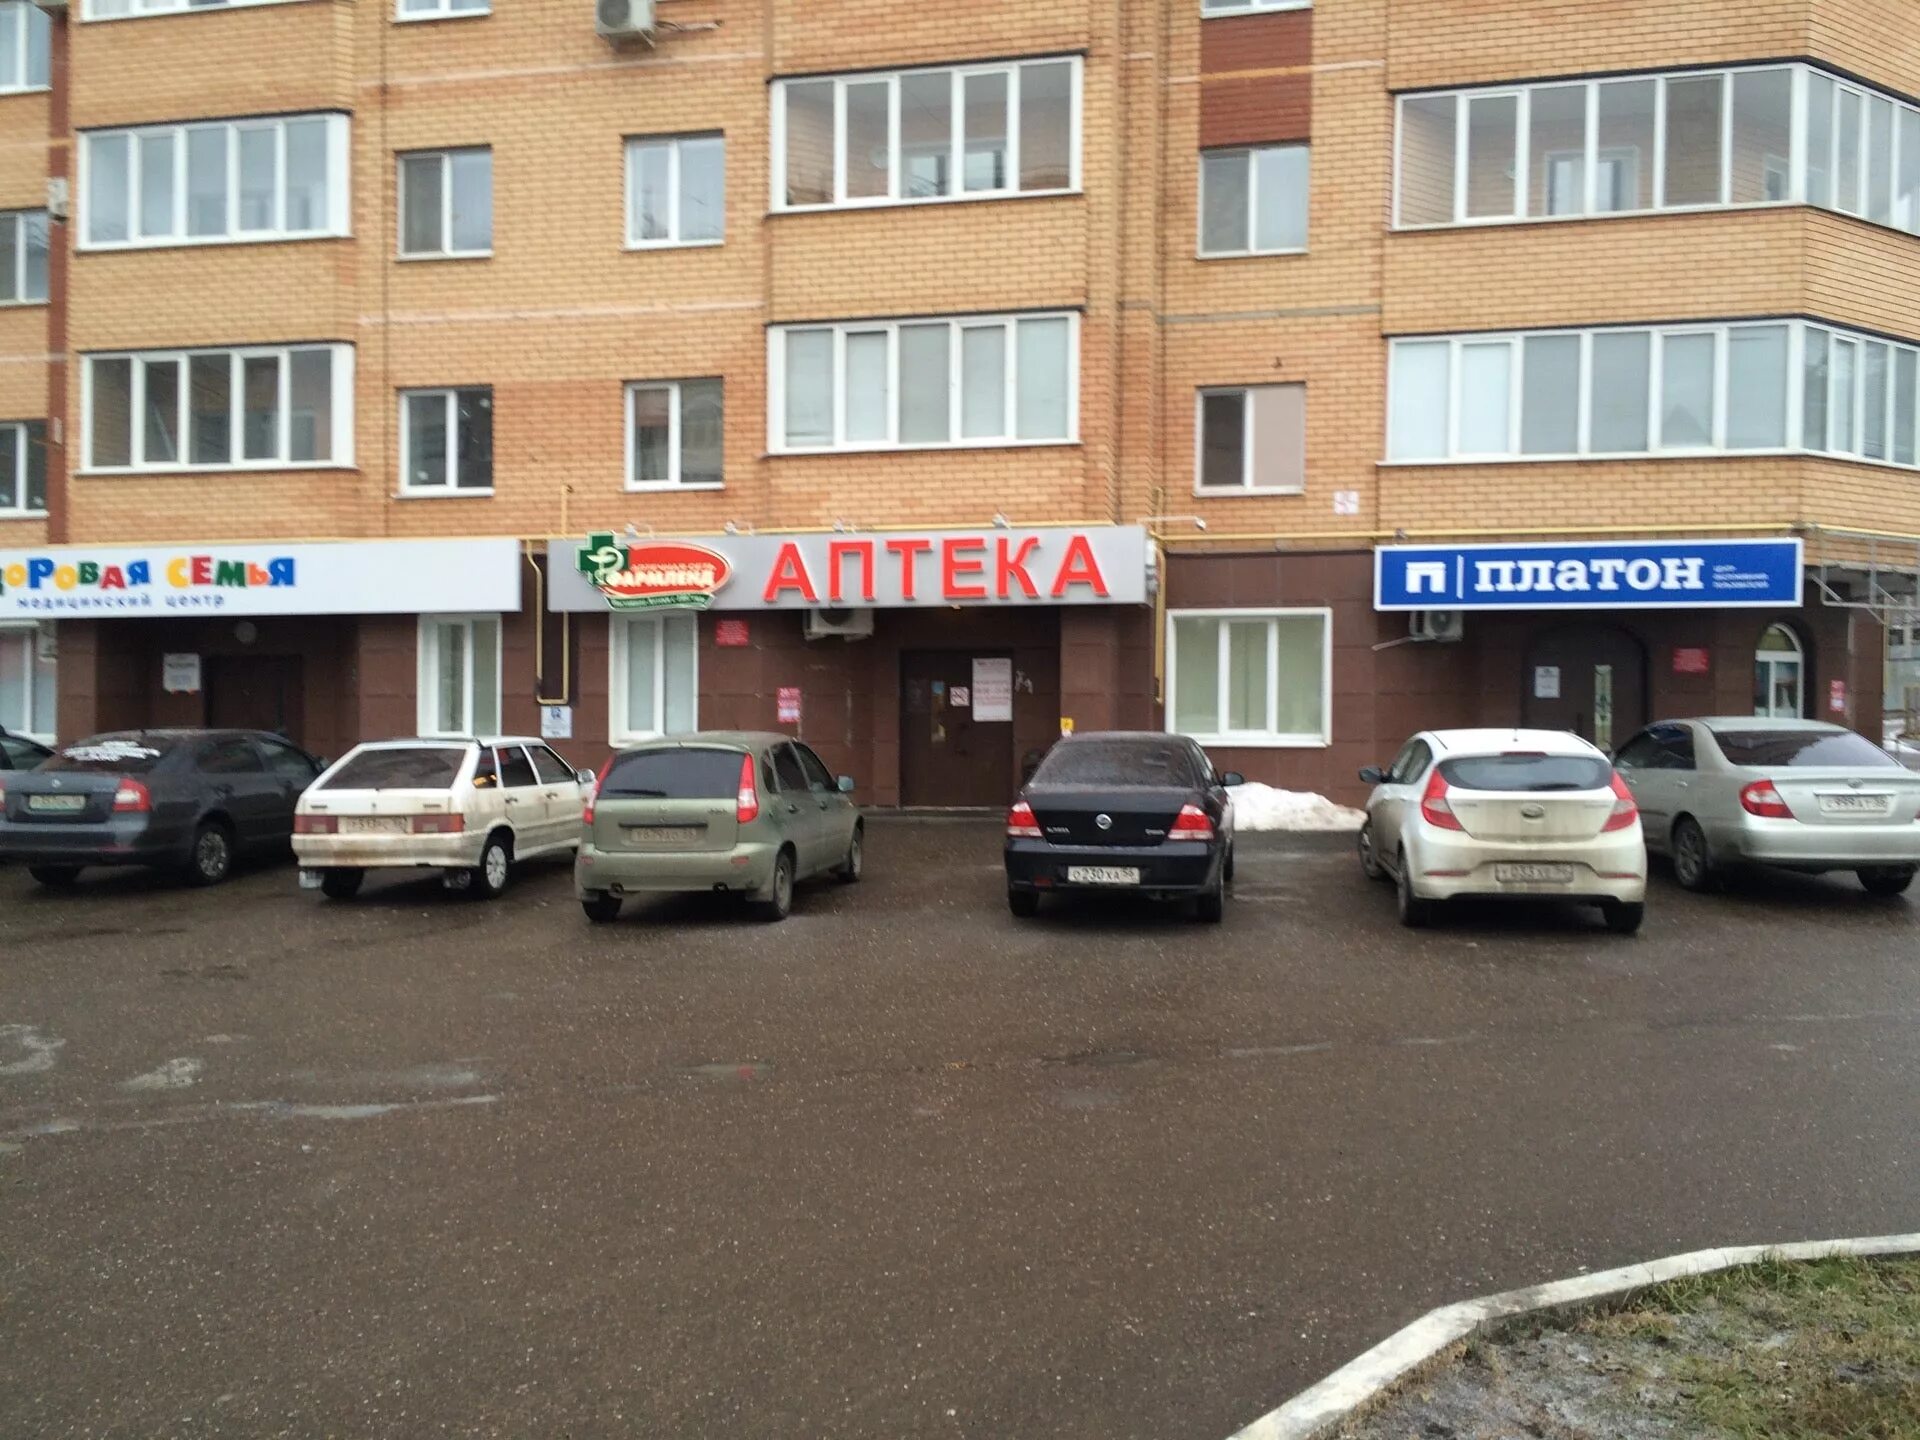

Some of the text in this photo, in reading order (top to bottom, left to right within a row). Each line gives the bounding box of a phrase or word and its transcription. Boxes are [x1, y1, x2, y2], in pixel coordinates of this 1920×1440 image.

[0, 556, 296, 594] ОРОВАЯ СЕМЬЯ
[763, 534, 1110, 603] АПТЕКА
